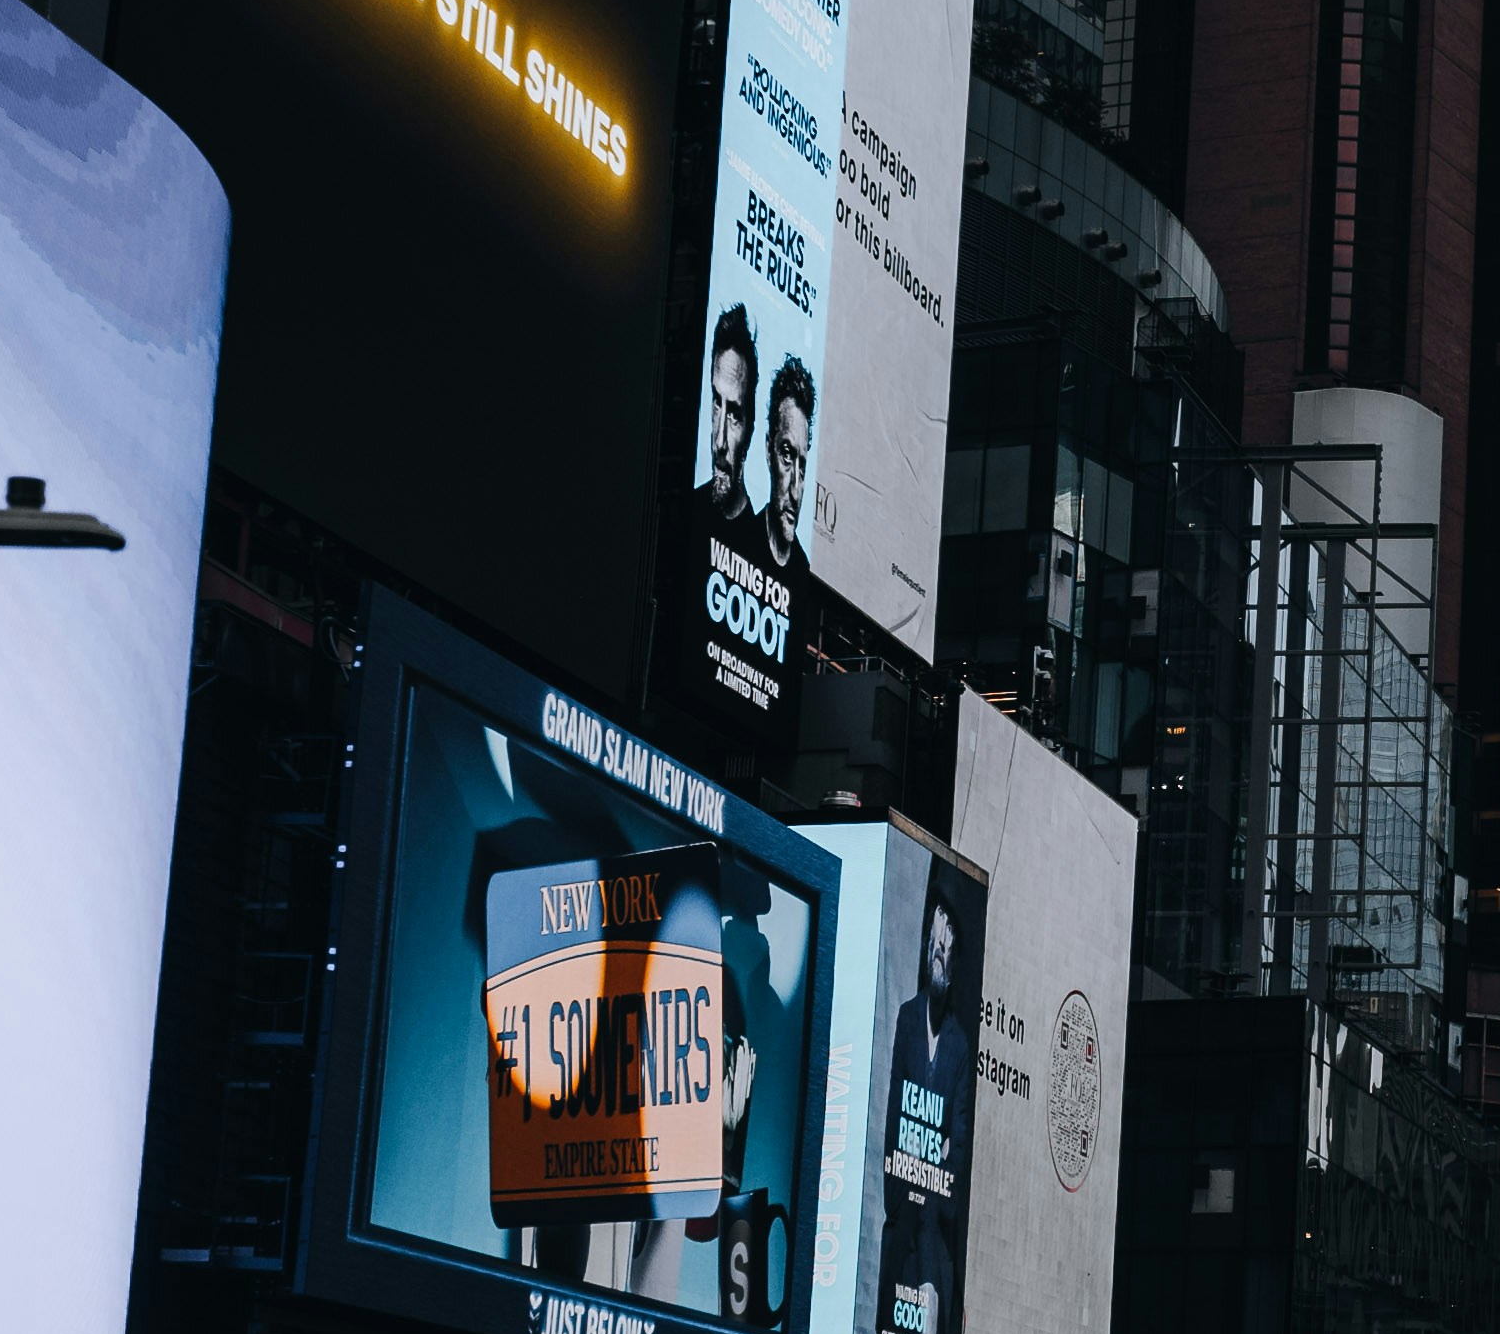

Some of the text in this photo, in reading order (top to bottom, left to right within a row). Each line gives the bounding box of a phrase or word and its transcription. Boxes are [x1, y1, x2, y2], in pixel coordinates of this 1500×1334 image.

[522, 48, 629, 179] SHINES
[739, 75, 765, 117] AND
[851, 109, 917, 200] campaign
[860, 162, 891, 222] bold
[736, 219, 763, 274] THE
[747, 189, 805, 269] BREAKS
[854, 210, 945, 329] this billboard.
[709, 536, 790, 617] WAITING FOR
[706, 571, 790, 664] GODOT
[706, 640, 779, 699] ON BROADWAY FOR
[724, 669, 751, 700] LIMITED
[752, 687, 770, 711] TIME
[543, 692, 726, 835] GRAND SLAM NEW YORK
[539, 872, 662, 936] NEW YORK
[495, 984, 711, 1123] #1 SOUVENIRS
[996, 997, 1026, 1046] it on
[901, 1078, 945, 1128] KEANU
[544, 1136, 660, 1180] EMPIRE STATE
[812, 1042, 853, 1290] WAITING FOR
[897, 1115, 943, 1166] REEVES
